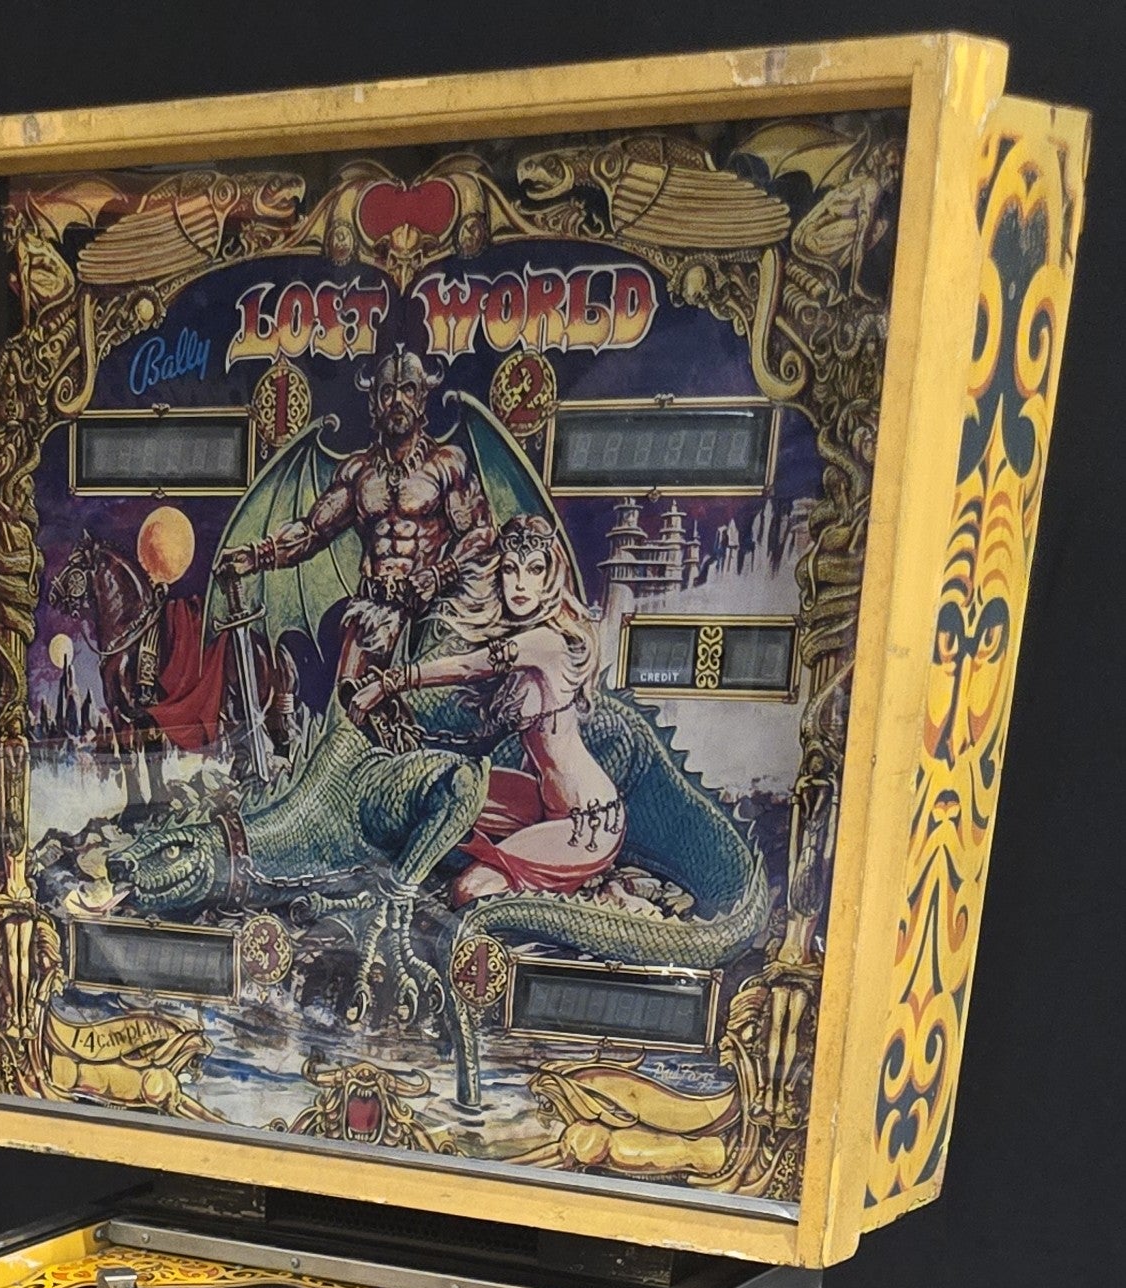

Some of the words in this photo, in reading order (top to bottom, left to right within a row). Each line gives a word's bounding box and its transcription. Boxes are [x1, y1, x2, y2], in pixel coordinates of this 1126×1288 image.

[225, 277, 390, 374] LOST
[411, 261, 660, 366] WORLD
[129, 327, 211, 395] Bally
[504, 358, 545, 424] 2
[274, 373, 290, 436] 1
[640, 671, 680, 683] CREDIT
[455, 942, 490, 996] 4
